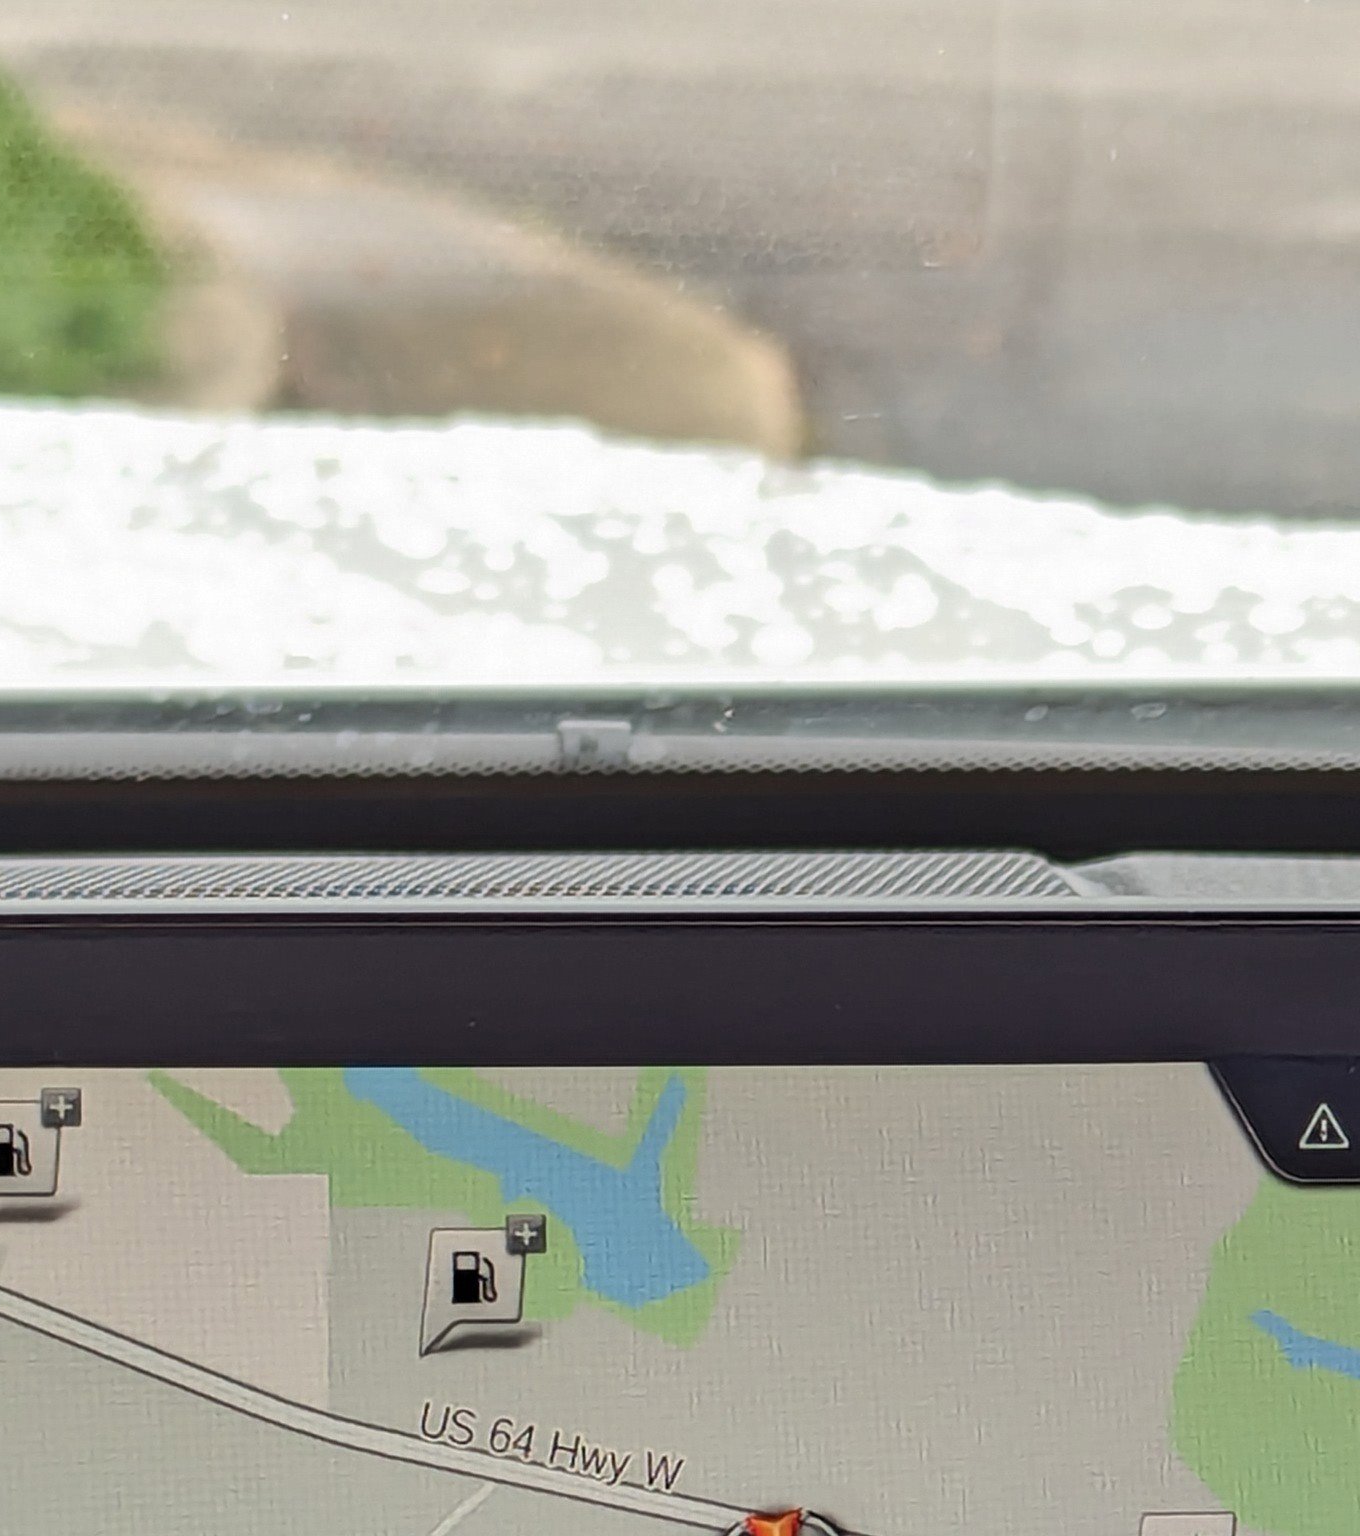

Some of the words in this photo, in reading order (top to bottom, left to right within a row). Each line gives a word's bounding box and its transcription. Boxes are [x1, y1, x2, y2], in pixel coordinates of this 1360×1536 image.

[419, 1402, 476, 1446] US
[489, 1416, 536, 1460] 64
[549, 1430, 632, 1487] Hwy
[646, 1455, 687, 1492] W
